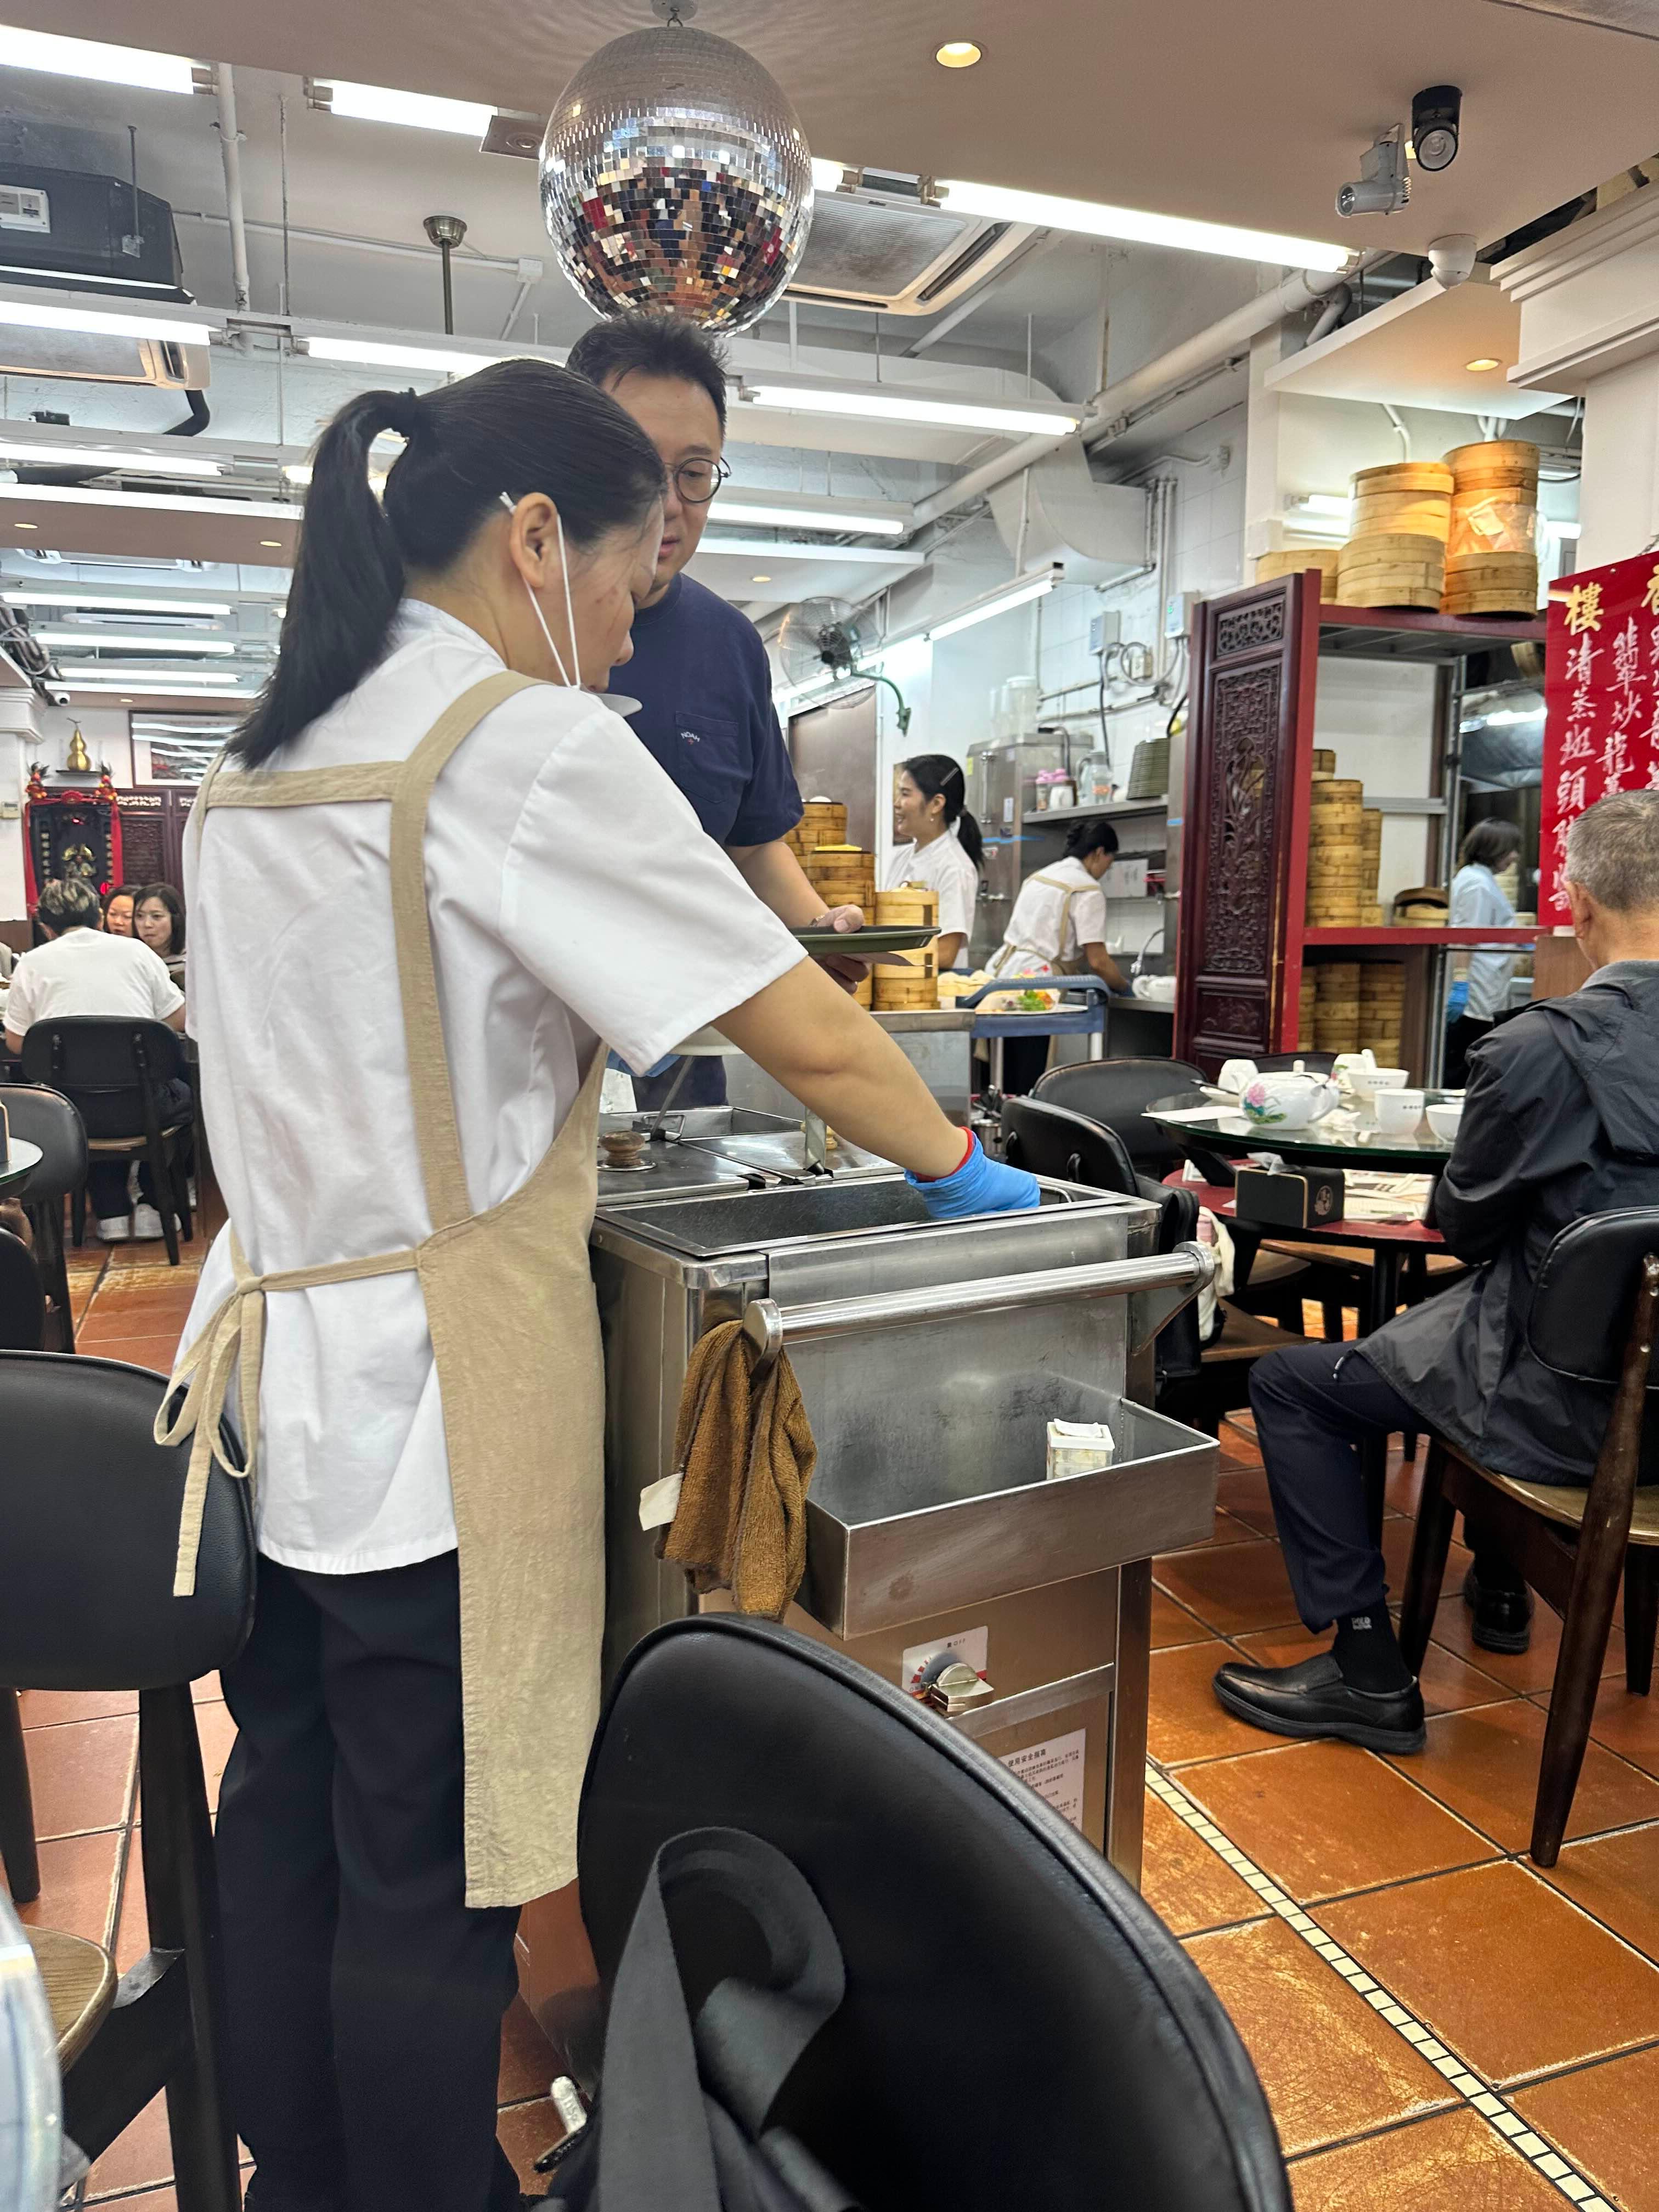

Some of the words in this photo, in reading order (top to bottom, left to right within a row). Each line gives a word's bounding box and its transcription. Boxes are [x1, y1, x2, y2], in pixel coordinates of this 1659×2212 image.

[1564, 581, 1604, 636] 樓
[680, 731, 700, 742] NOAH
[953, 1638, 966, 1646] OFF
